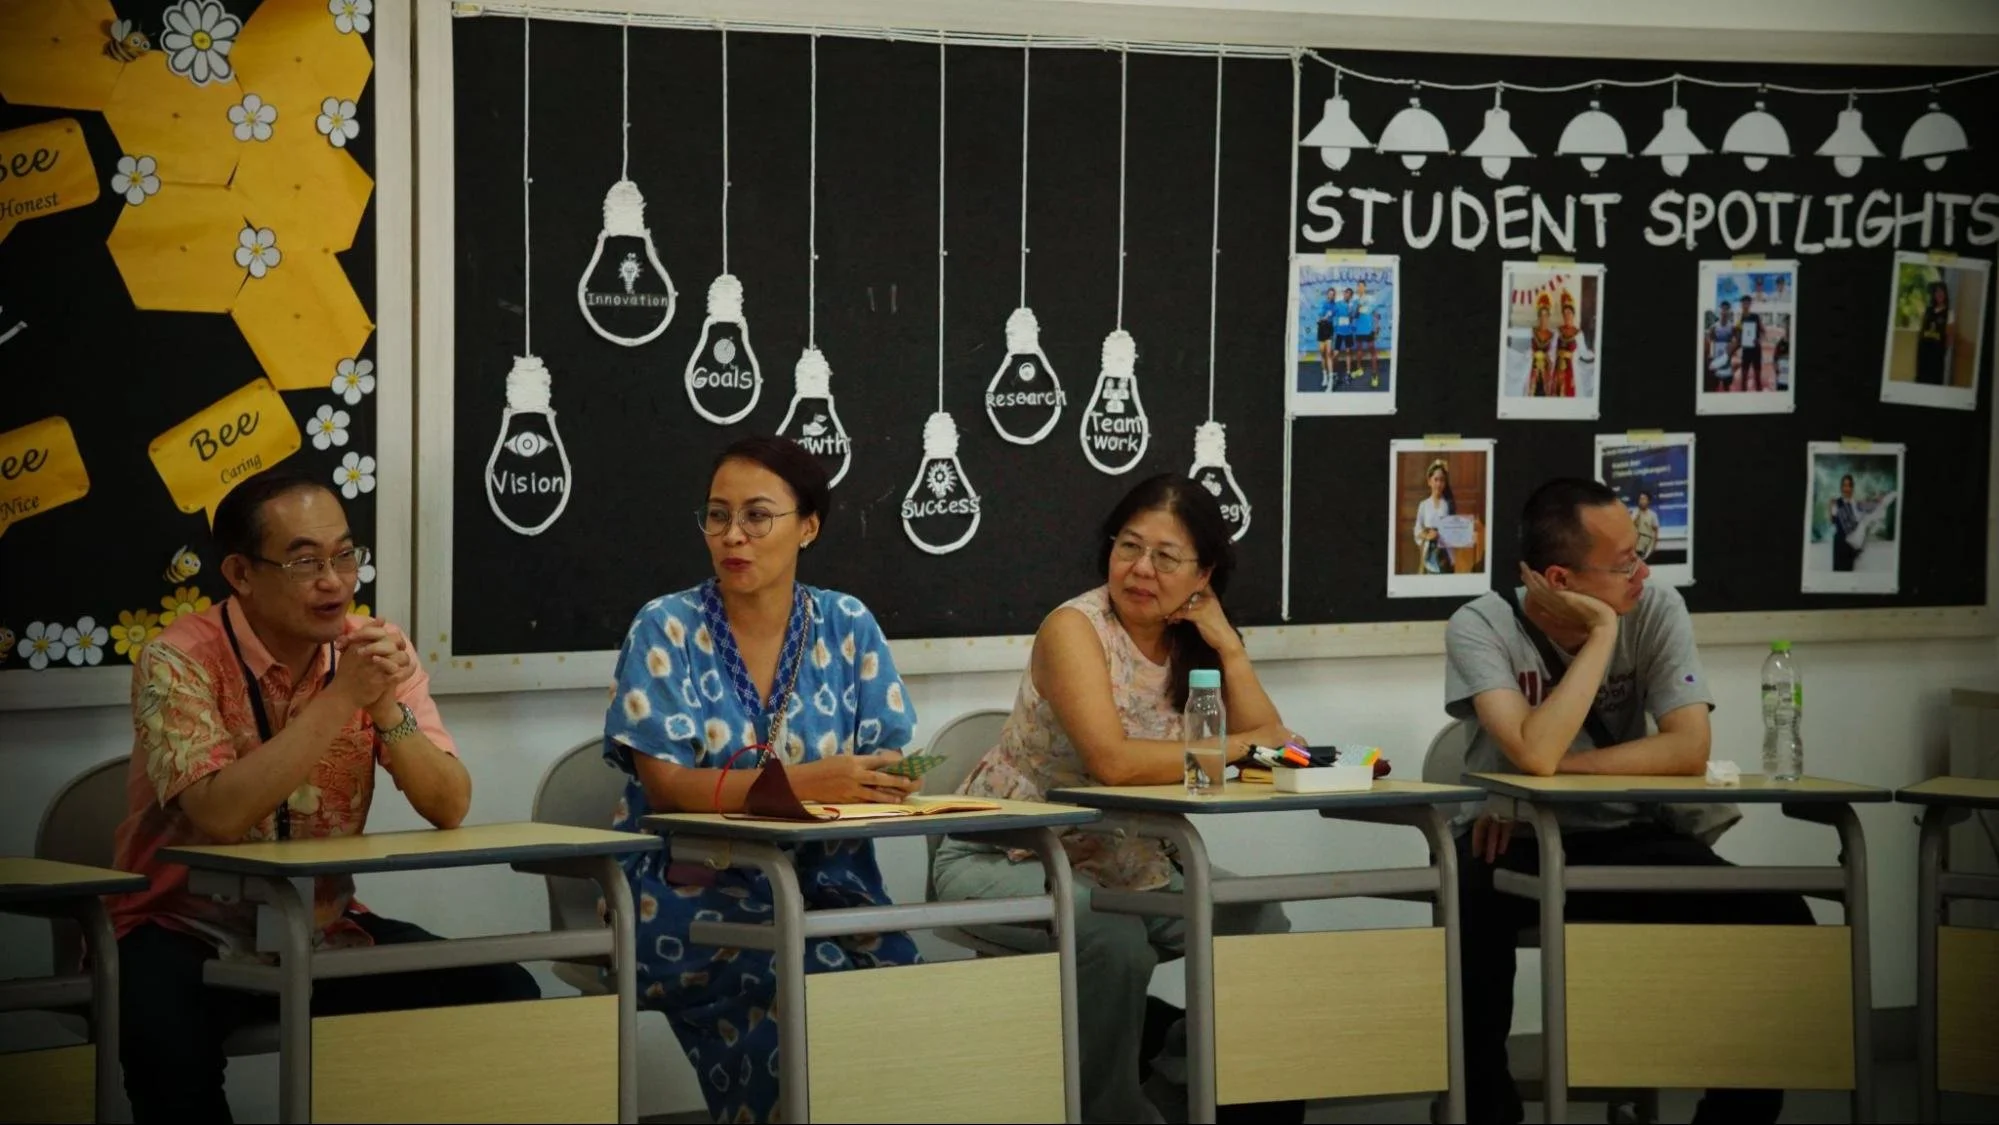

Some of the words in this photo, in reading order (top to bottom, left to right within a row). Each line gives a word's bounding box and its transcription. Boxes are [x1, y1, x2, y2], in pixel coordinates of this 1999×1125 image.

[0, 192, 59, 220] Honest
[1302, 181, 1622, 252] STUDENT
[1644, 189, 1999, 254] SPOTLIGHTS
[587, 292, 669, 307] Innovation
[691, 365, 753, 389] Goals
[986, 389, 1066, 407] Research
[1090, 411, 1142, 433] Team
[189, 411, 260, 461] Bee
[0, 447, 49, 481] ee
[220, 454, 263, 485] Caring
[491, 469, 565, 495] Vision
[0, 495, 41, 521] Nice
[901, 495, 981, 520] Success
